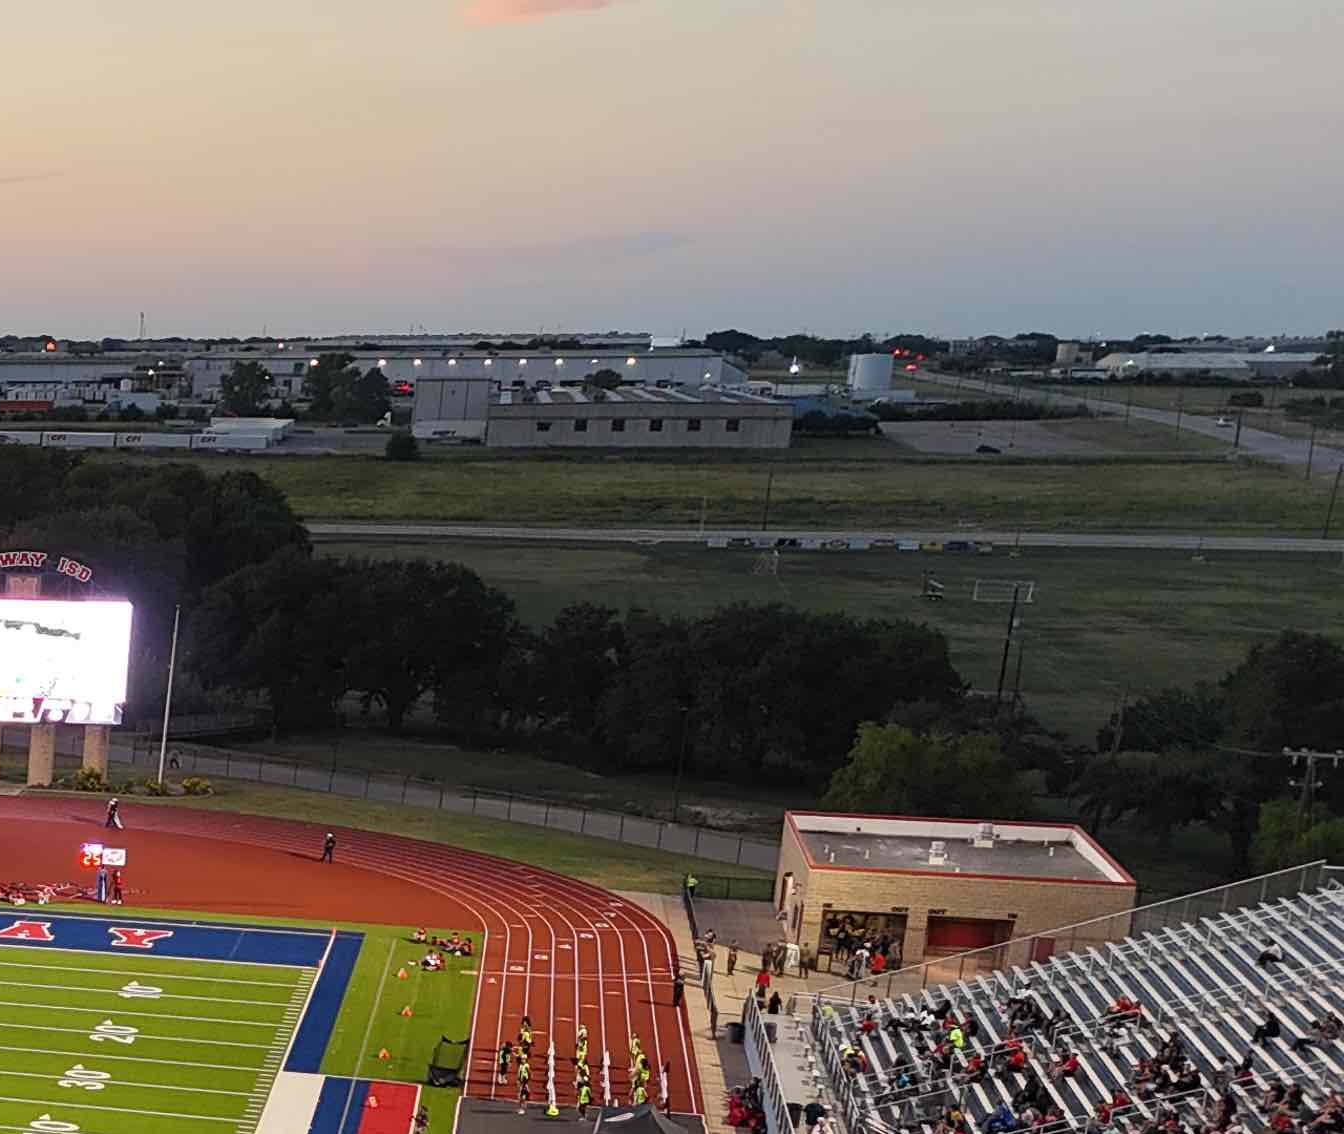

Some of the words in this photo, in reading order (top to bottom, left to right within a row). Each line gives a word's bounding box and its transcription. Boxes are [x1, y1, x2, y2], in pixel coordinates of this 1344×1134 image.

[56, 556, 93, 583] ISD
[82, 852, 102, 866] 25
[117, 984, 163, 1000] 10
[88, 1024, 139, 1044] 20
[57, 1069, 112, 1090] 30
